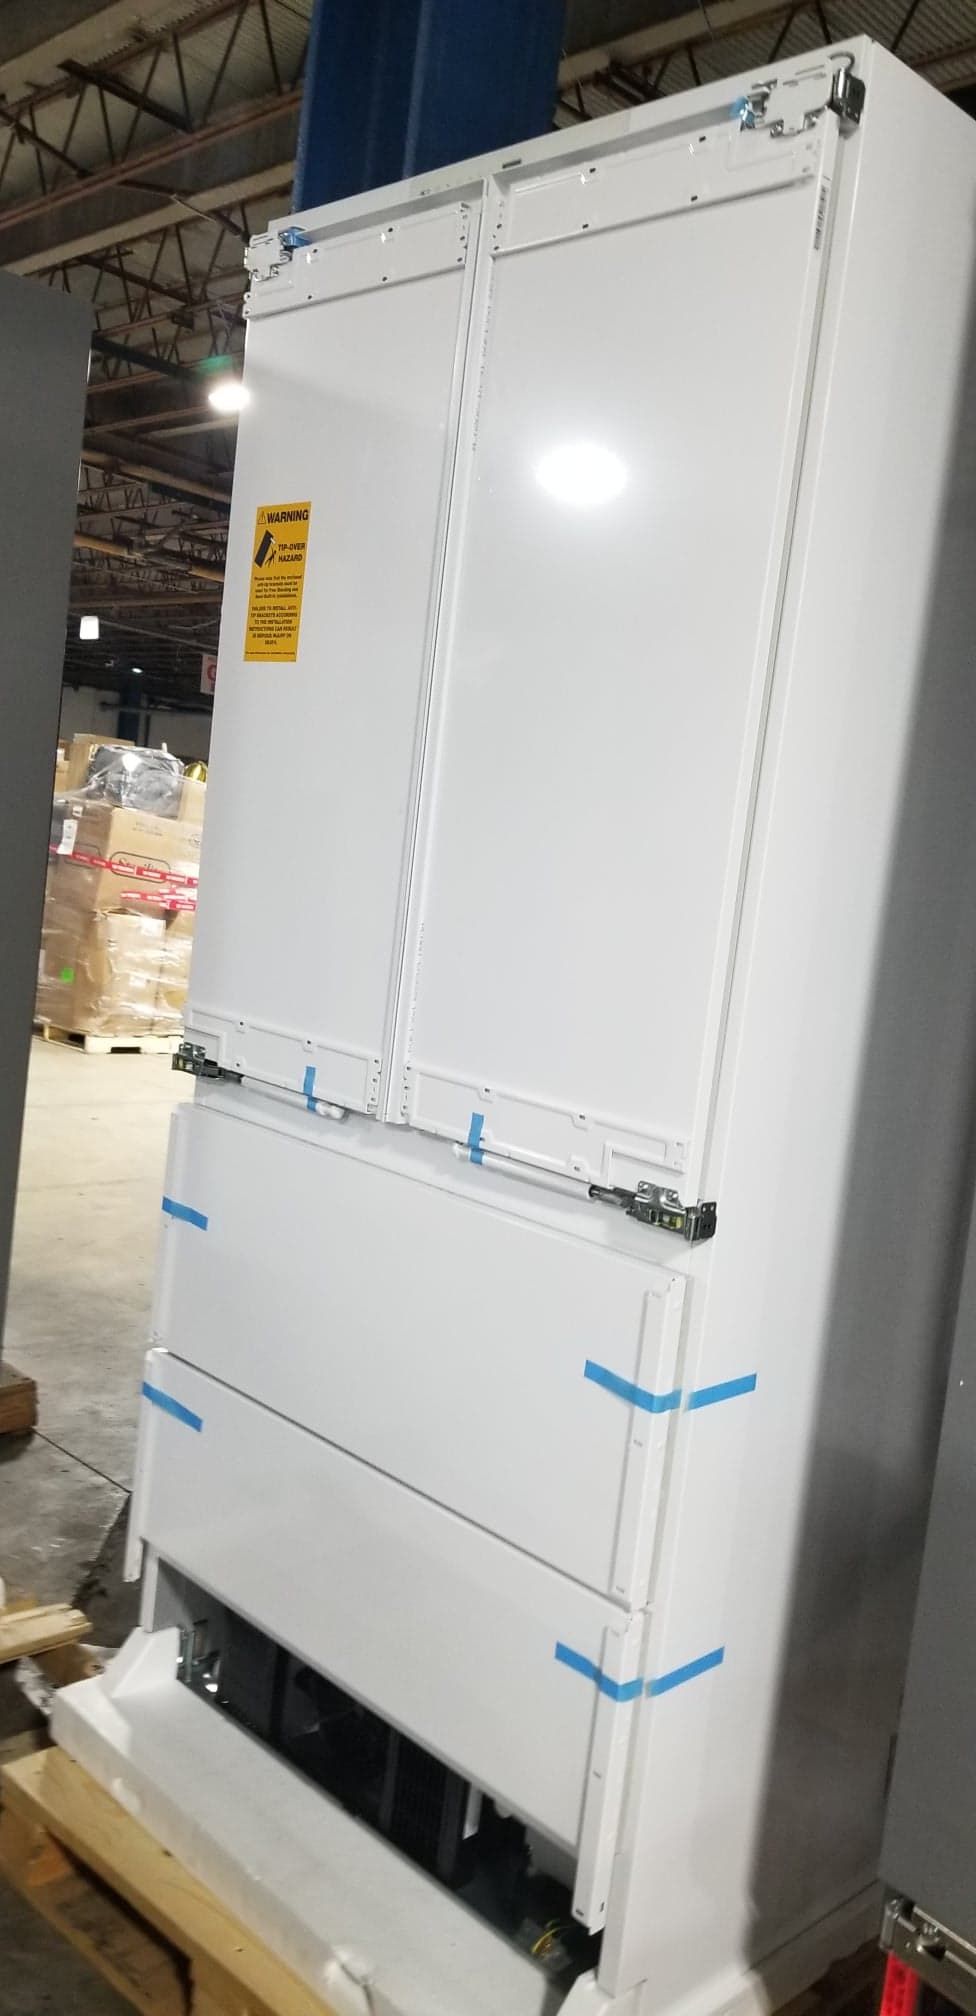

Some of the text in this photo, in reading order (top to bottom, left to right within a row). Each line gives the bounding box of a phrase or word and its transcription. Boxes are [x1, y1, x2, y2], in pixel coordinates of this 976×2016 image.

[267, 509, 309, 524] WARNING
[278, 542, 305, 551] TIP-OVER
[278, 554, 303, 562] HAZARD
